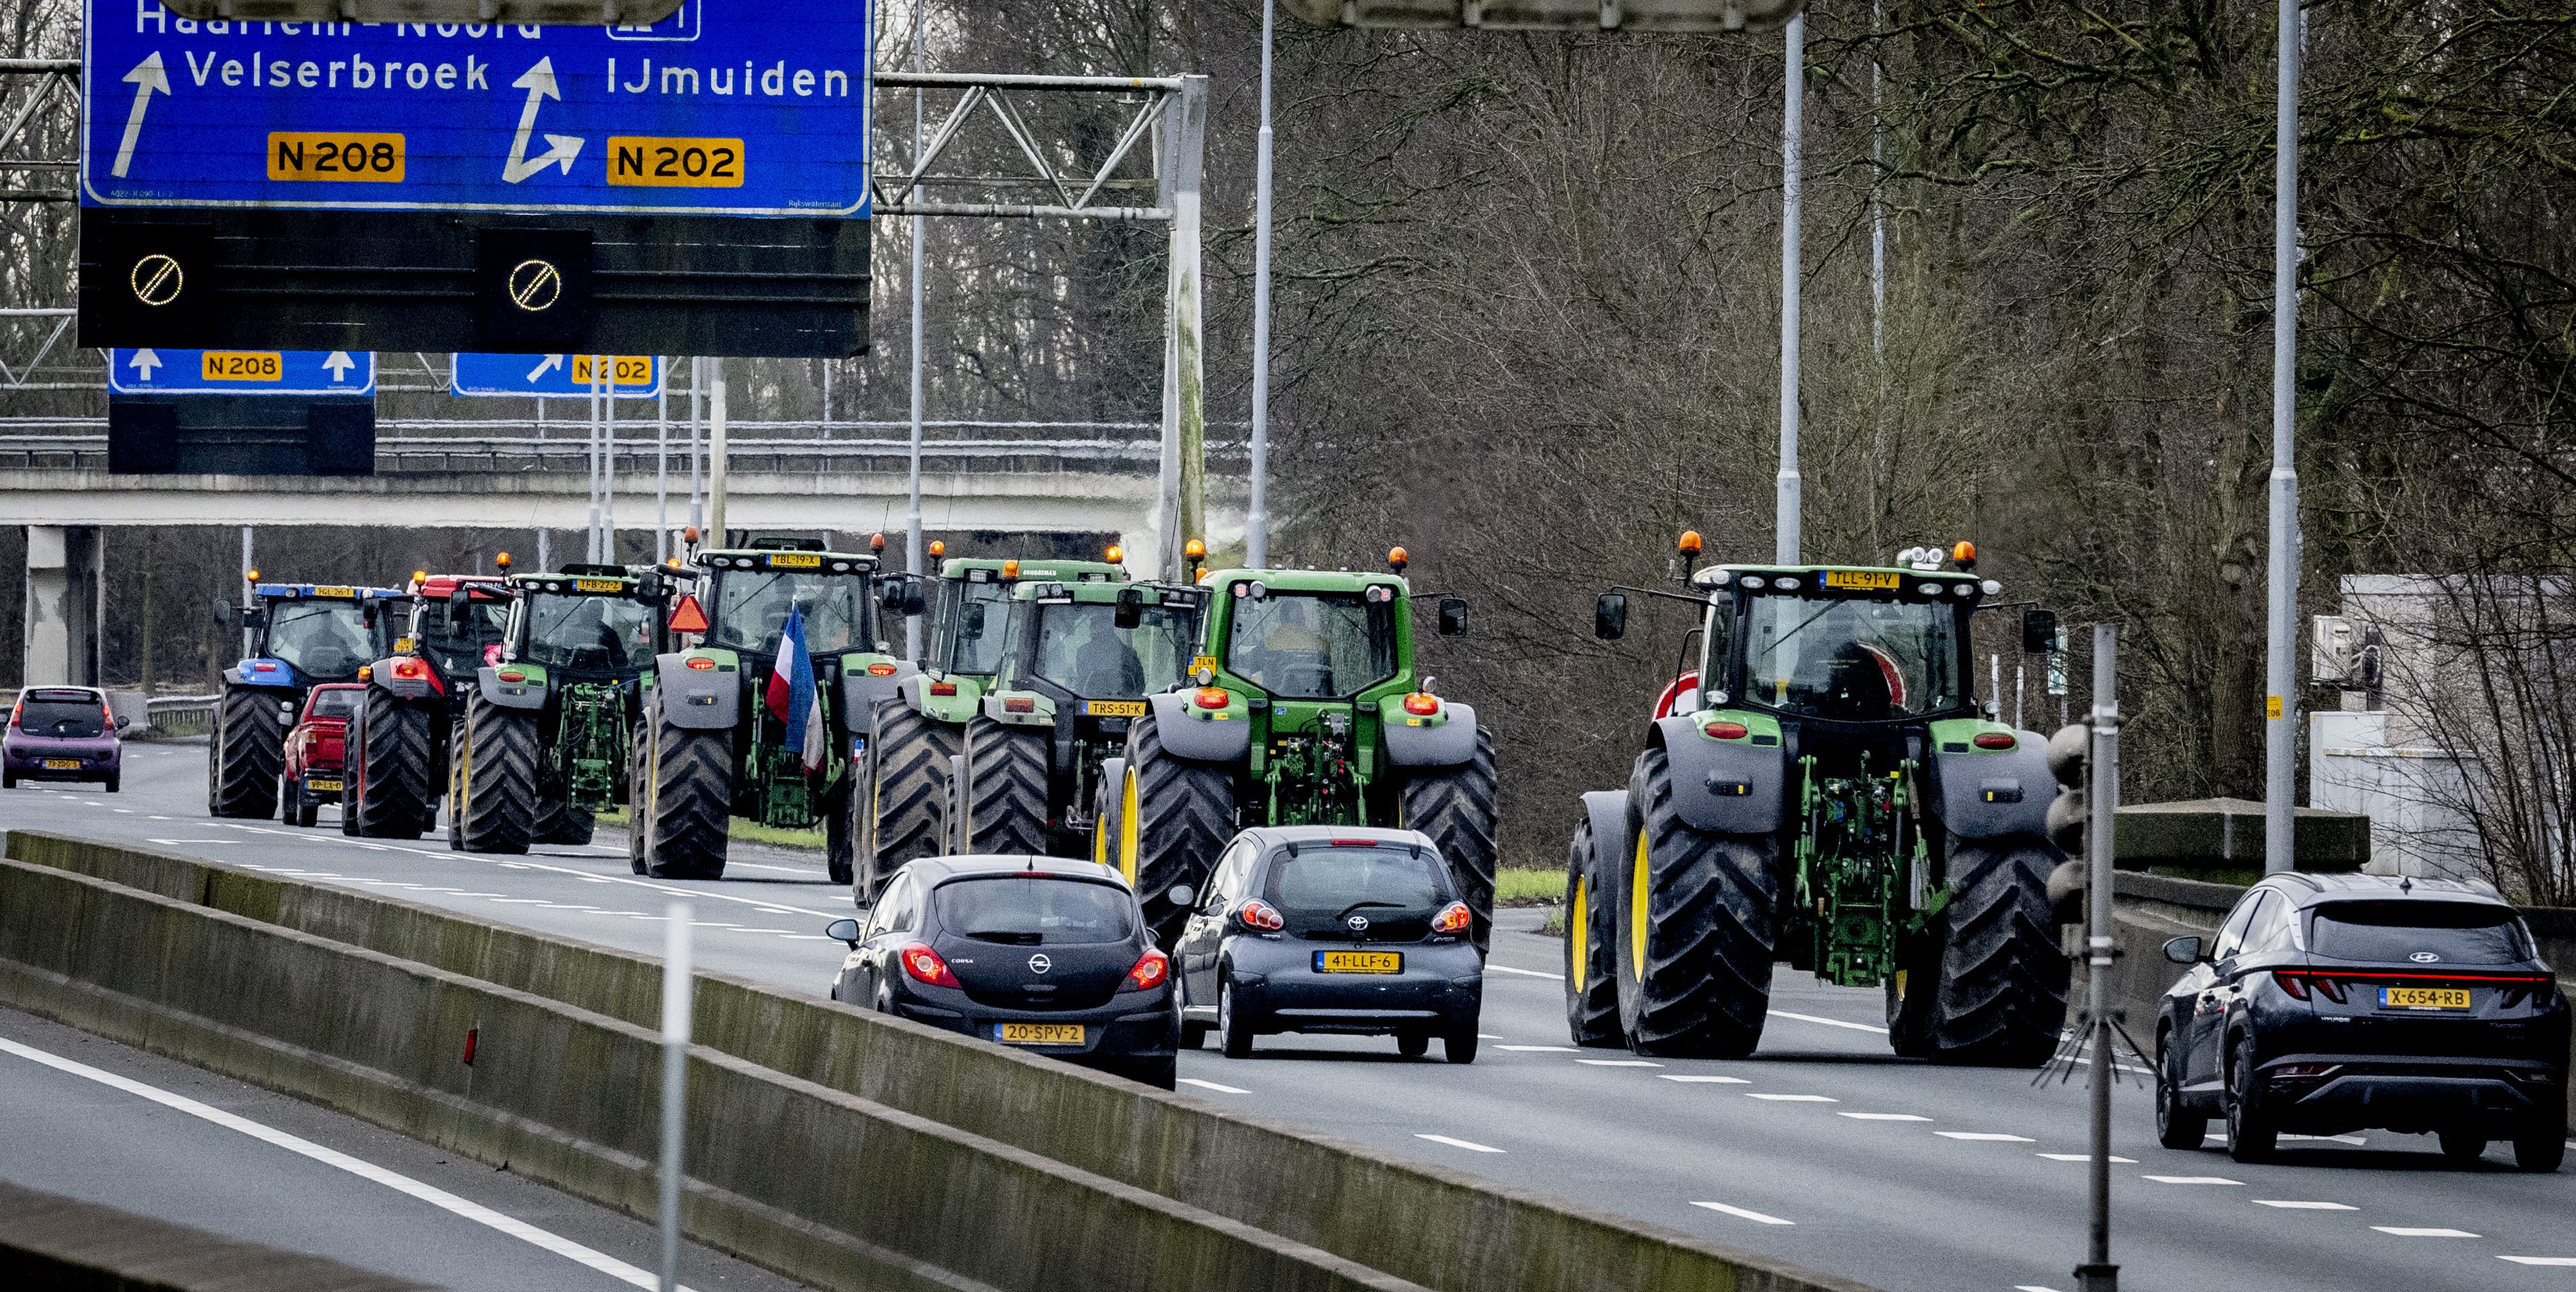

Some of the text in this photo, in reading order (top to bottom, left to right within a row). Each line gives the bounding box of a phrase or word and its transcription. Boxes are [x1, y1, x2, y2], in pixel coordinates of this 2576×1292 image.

[185, 50, 489, 90] Velserbroek
[607, 58, 848, 97] IJmuiden
[279, 141, 395, 172] N 208
[618, 146, 735, 177] N 202
[209, 357, 277, 375] N 208
[579, 361, 593, 378] N
[775, 555, 815, 564] TBL-19-X
[1834, 572, 1892, 586] TLL-91-V
[1197, 658, 1214, 666] TLN
[1093, 704, 1141, 714] TRS-51-K
[1332, 955, 1391, 967] 41-LLF-6
[2391, 990, 2464, 1005] X-654-RB
[1008, 1025, 1079, 1040] 20-SPV-2
